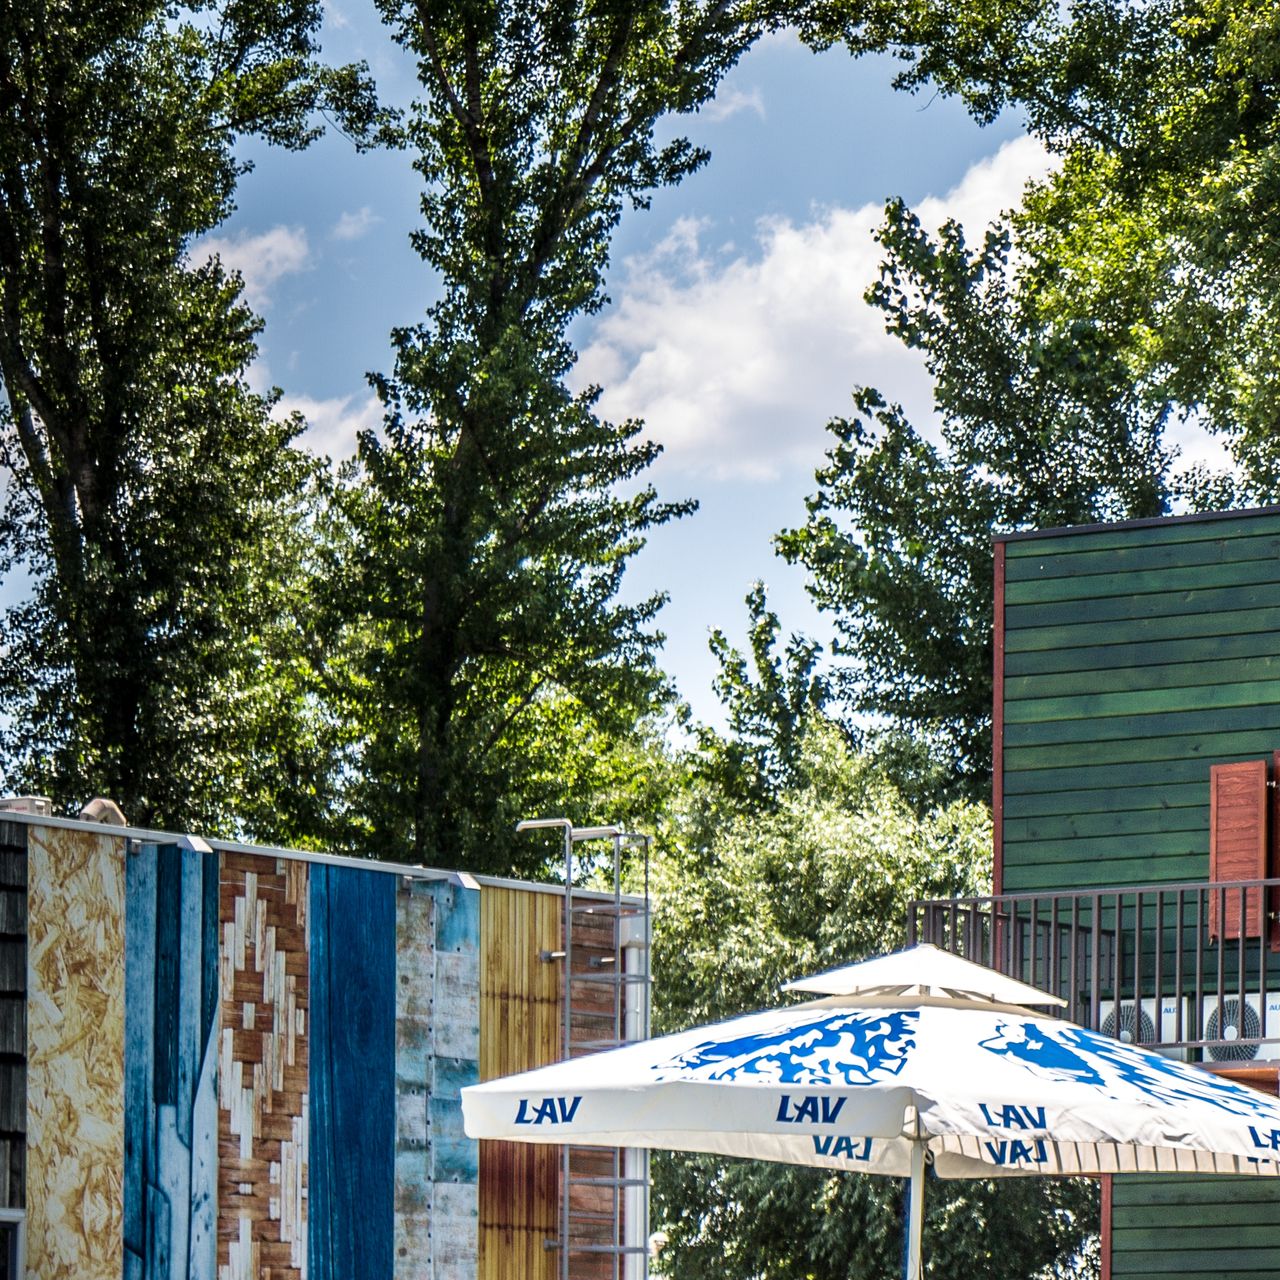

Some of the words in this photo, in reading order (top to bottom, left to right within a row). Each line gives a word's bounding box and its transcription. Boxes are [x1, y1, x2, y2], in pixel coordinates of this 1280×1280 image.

[514, 1096, 583, 1125] LAV
[776, 1094, 848, 1124] LAV
[978, 1103, 1047, 1130] LAV
